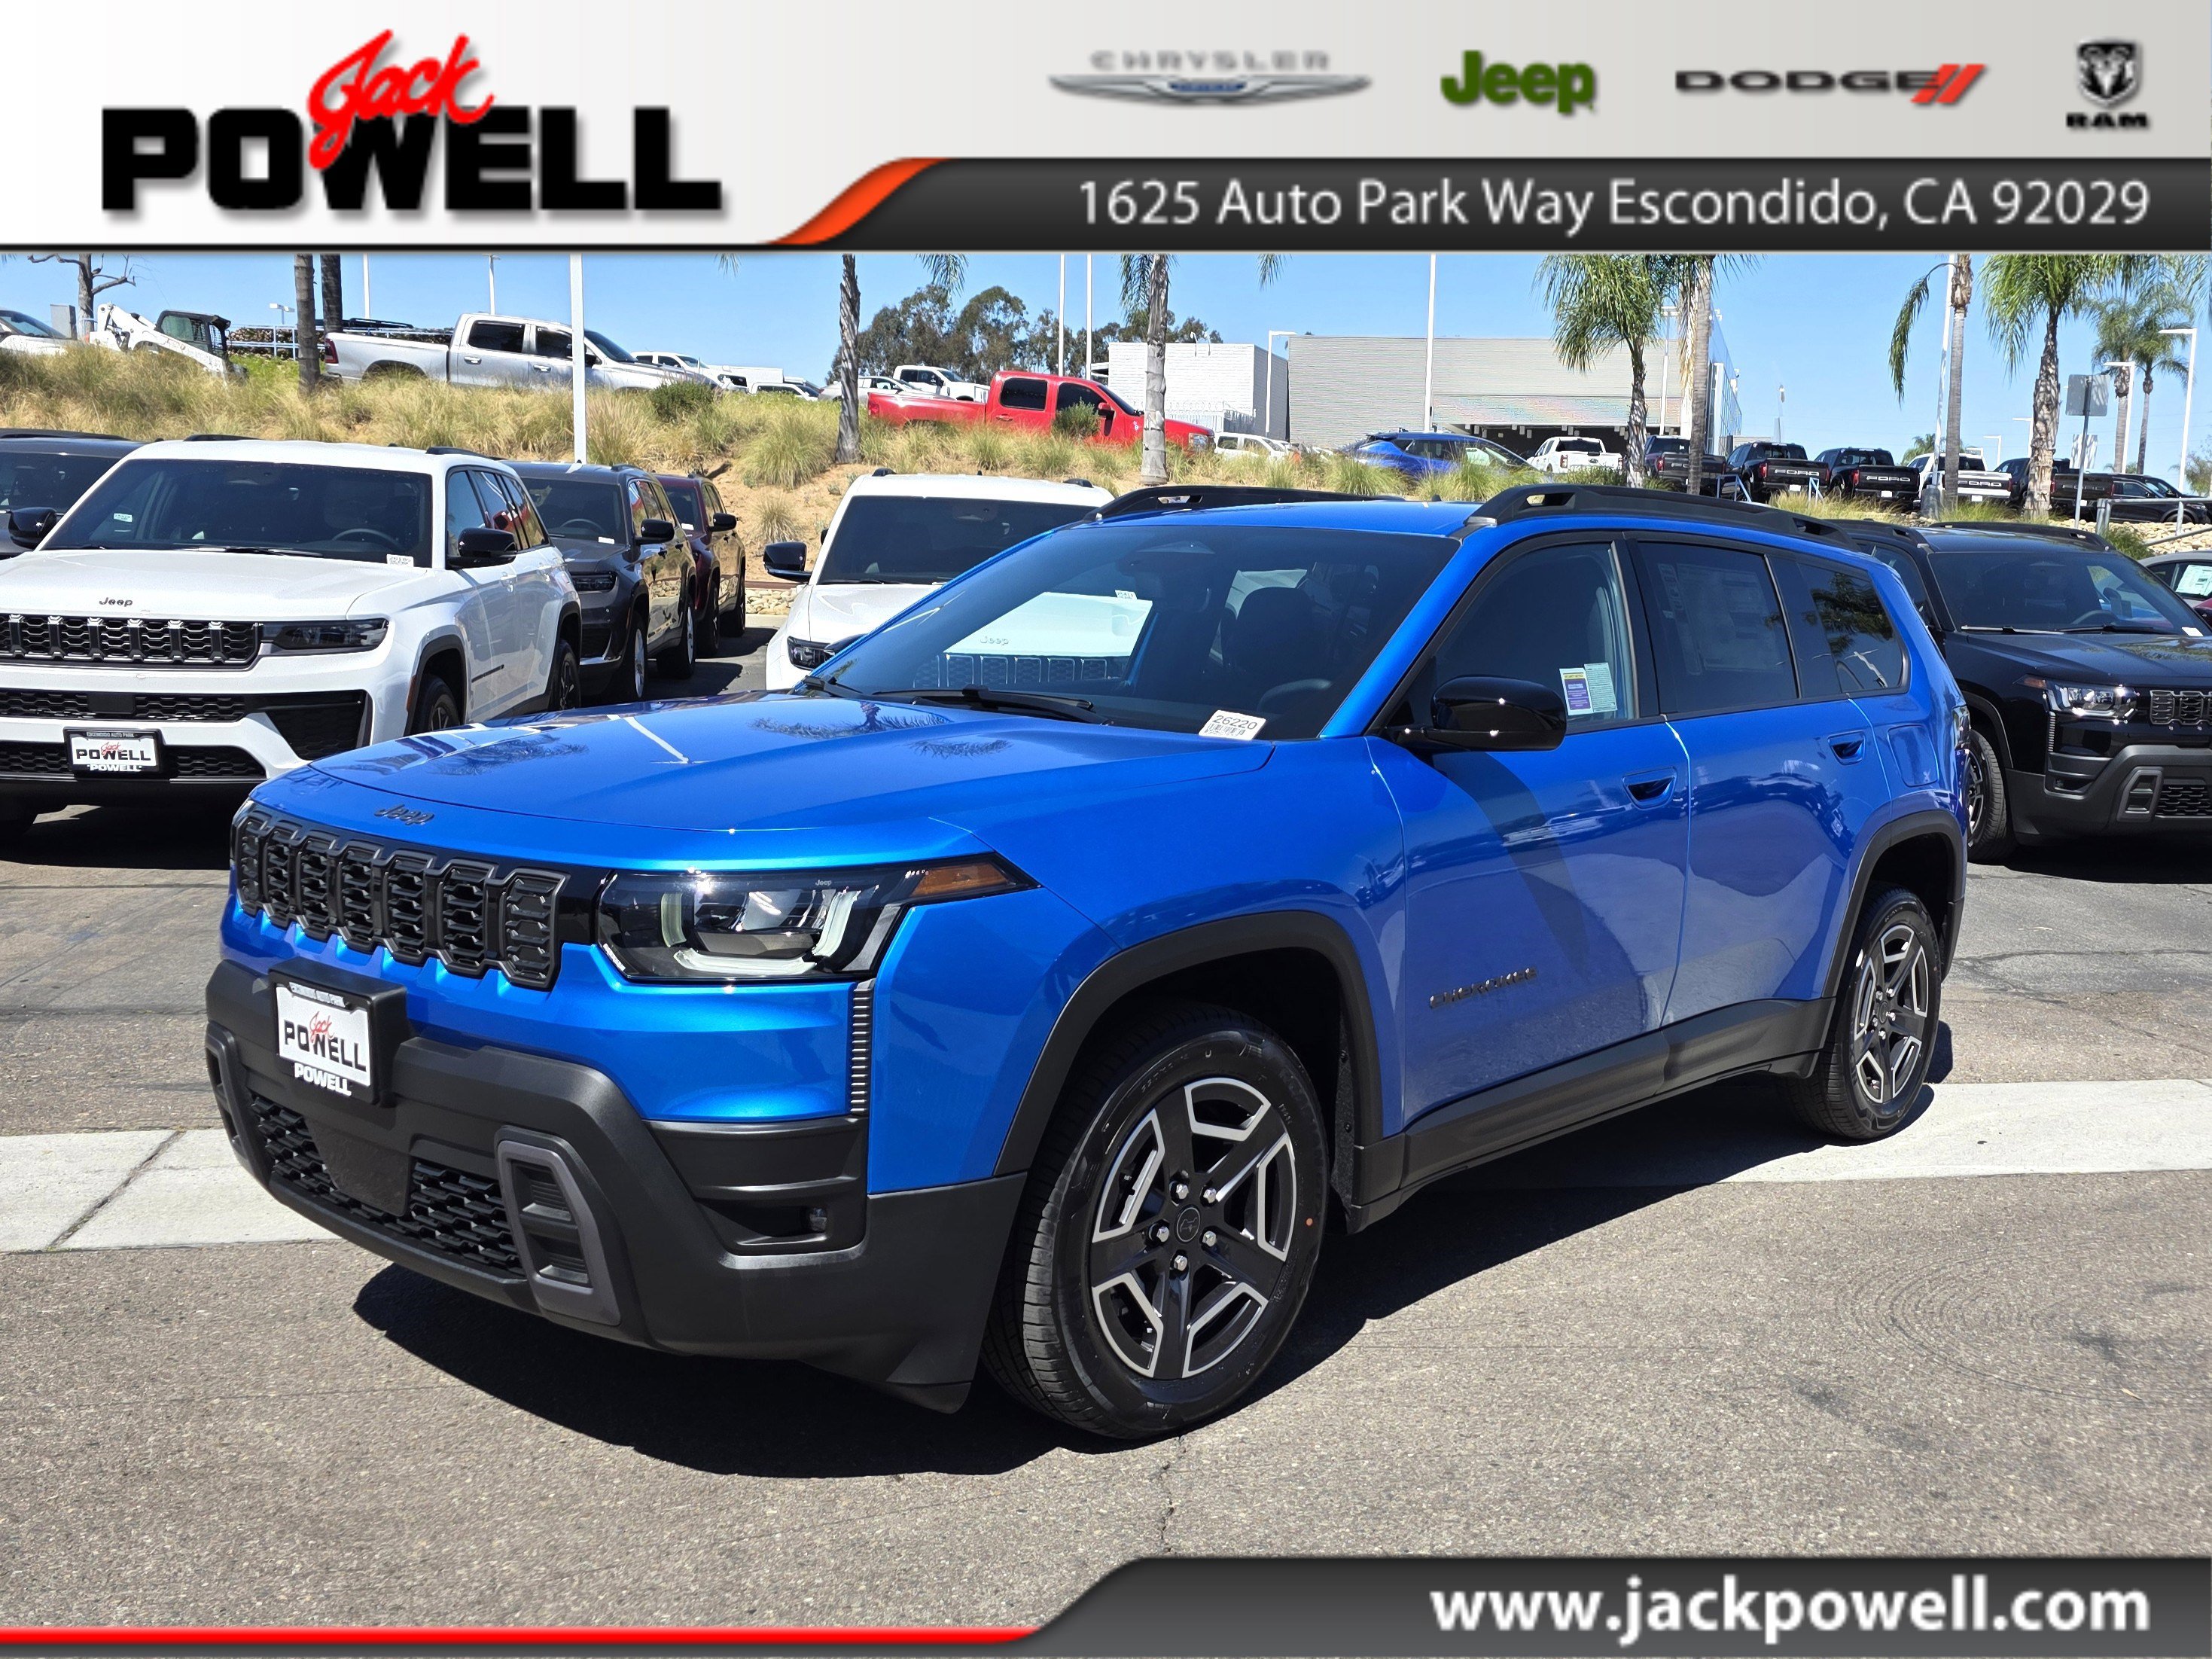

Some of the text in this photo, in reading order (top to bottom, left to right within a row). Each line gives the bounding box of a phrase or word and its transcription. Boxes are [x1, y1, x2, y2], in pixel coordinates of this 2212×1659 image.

[99, 597, 133, 607] Jeep
[1212, 715, 1258, 730] 26220
[76, 749, 151, 761] POWELL
[101, 742, 123, 757] Jack
[90, 764, 142, 772] POWELL
[374, 804, 435, 825] Jeep
[309, 1011, 335, 1044] Jack
[284, 1019, 367, 1072] POWELL
[294, 1063, 352, 1096] POWELL
